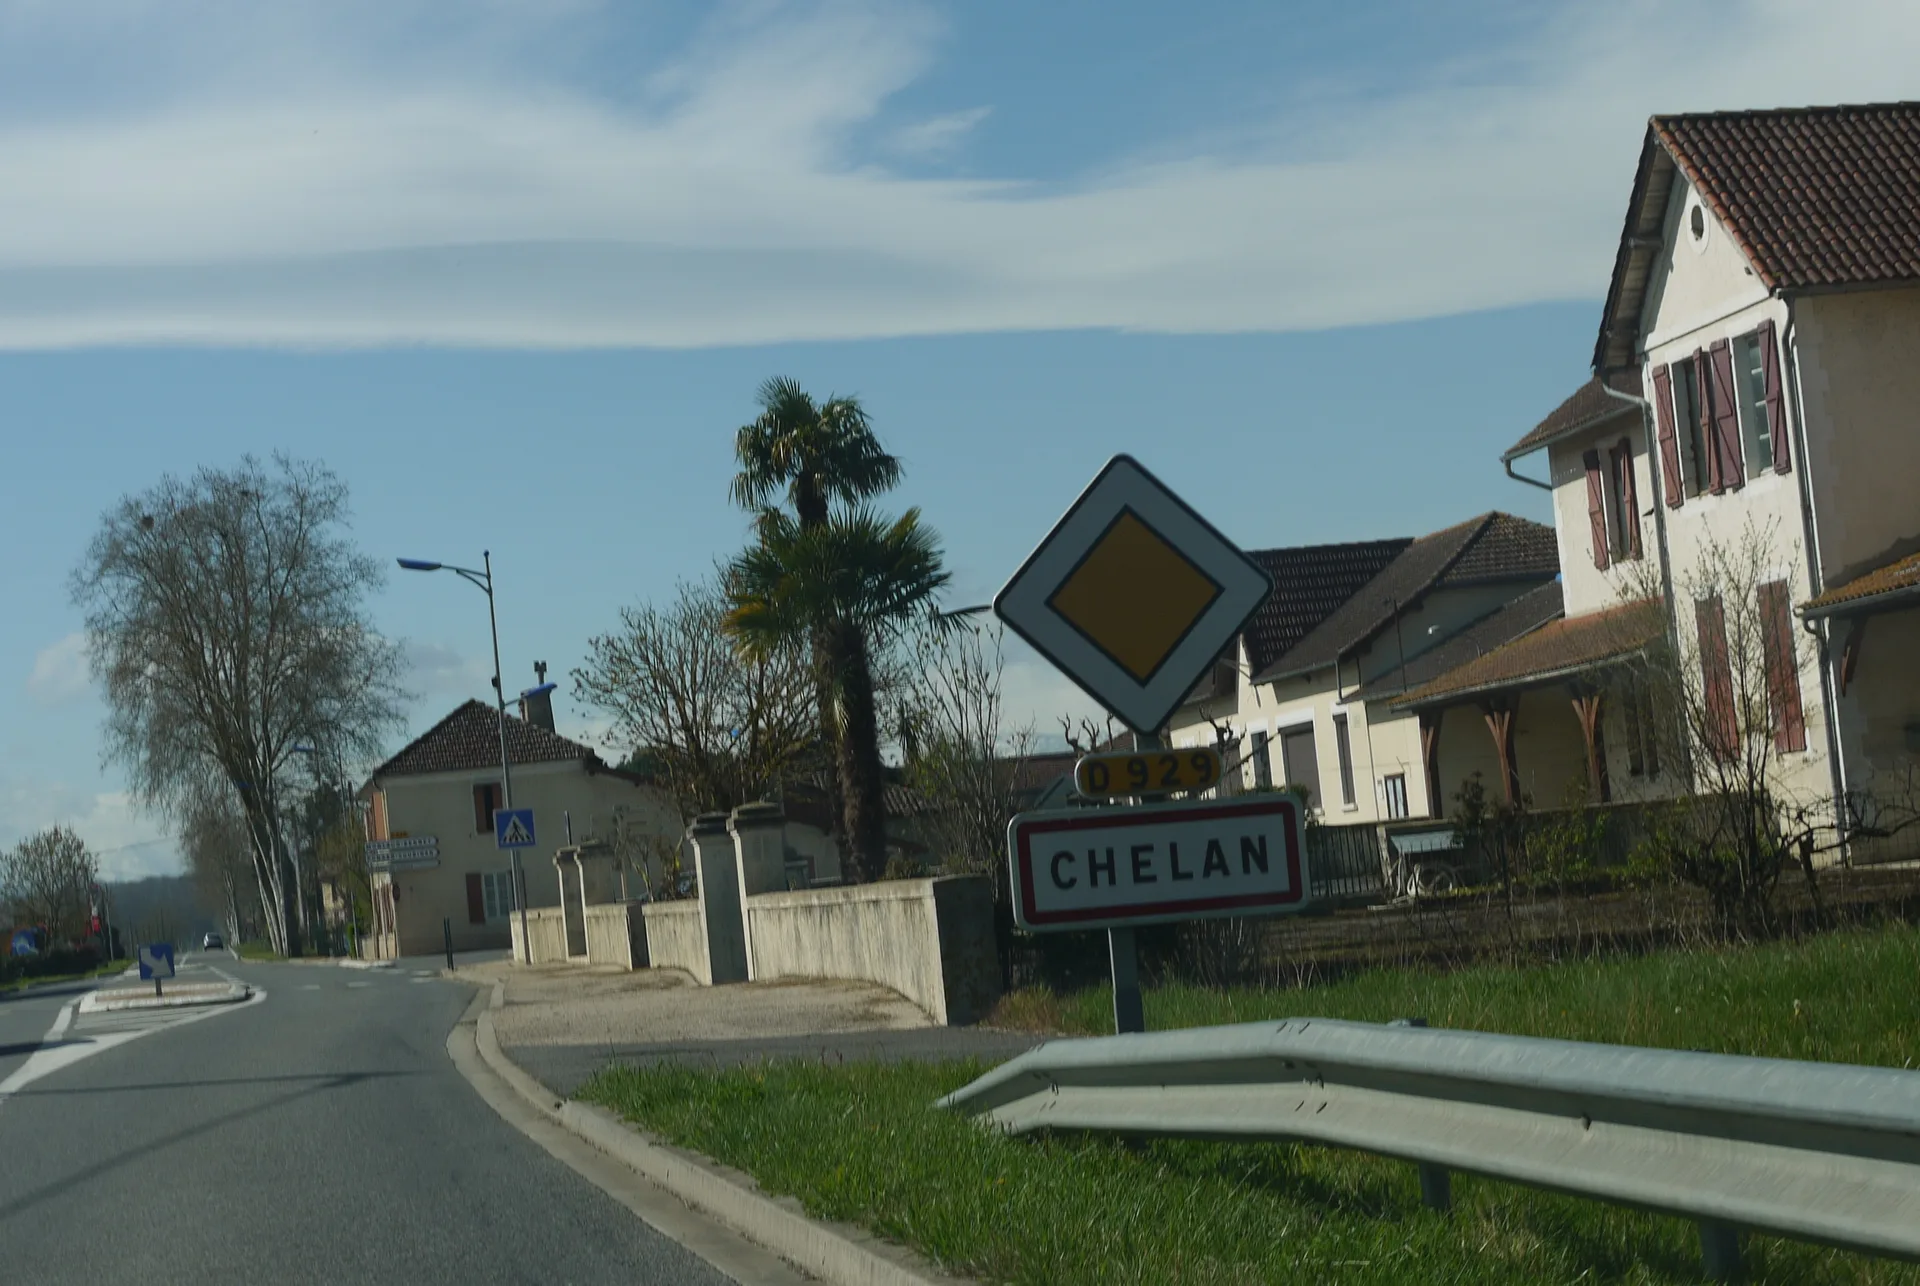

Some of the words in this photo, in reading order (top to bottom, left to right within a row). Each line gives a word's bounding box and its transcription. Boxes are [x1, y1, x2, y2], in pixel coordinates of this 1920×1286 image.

[1088, 761, 1110, 794] D
[1126, 752, 1212, 790] 929
[1050, 835, 1269, 890] CHELAN
